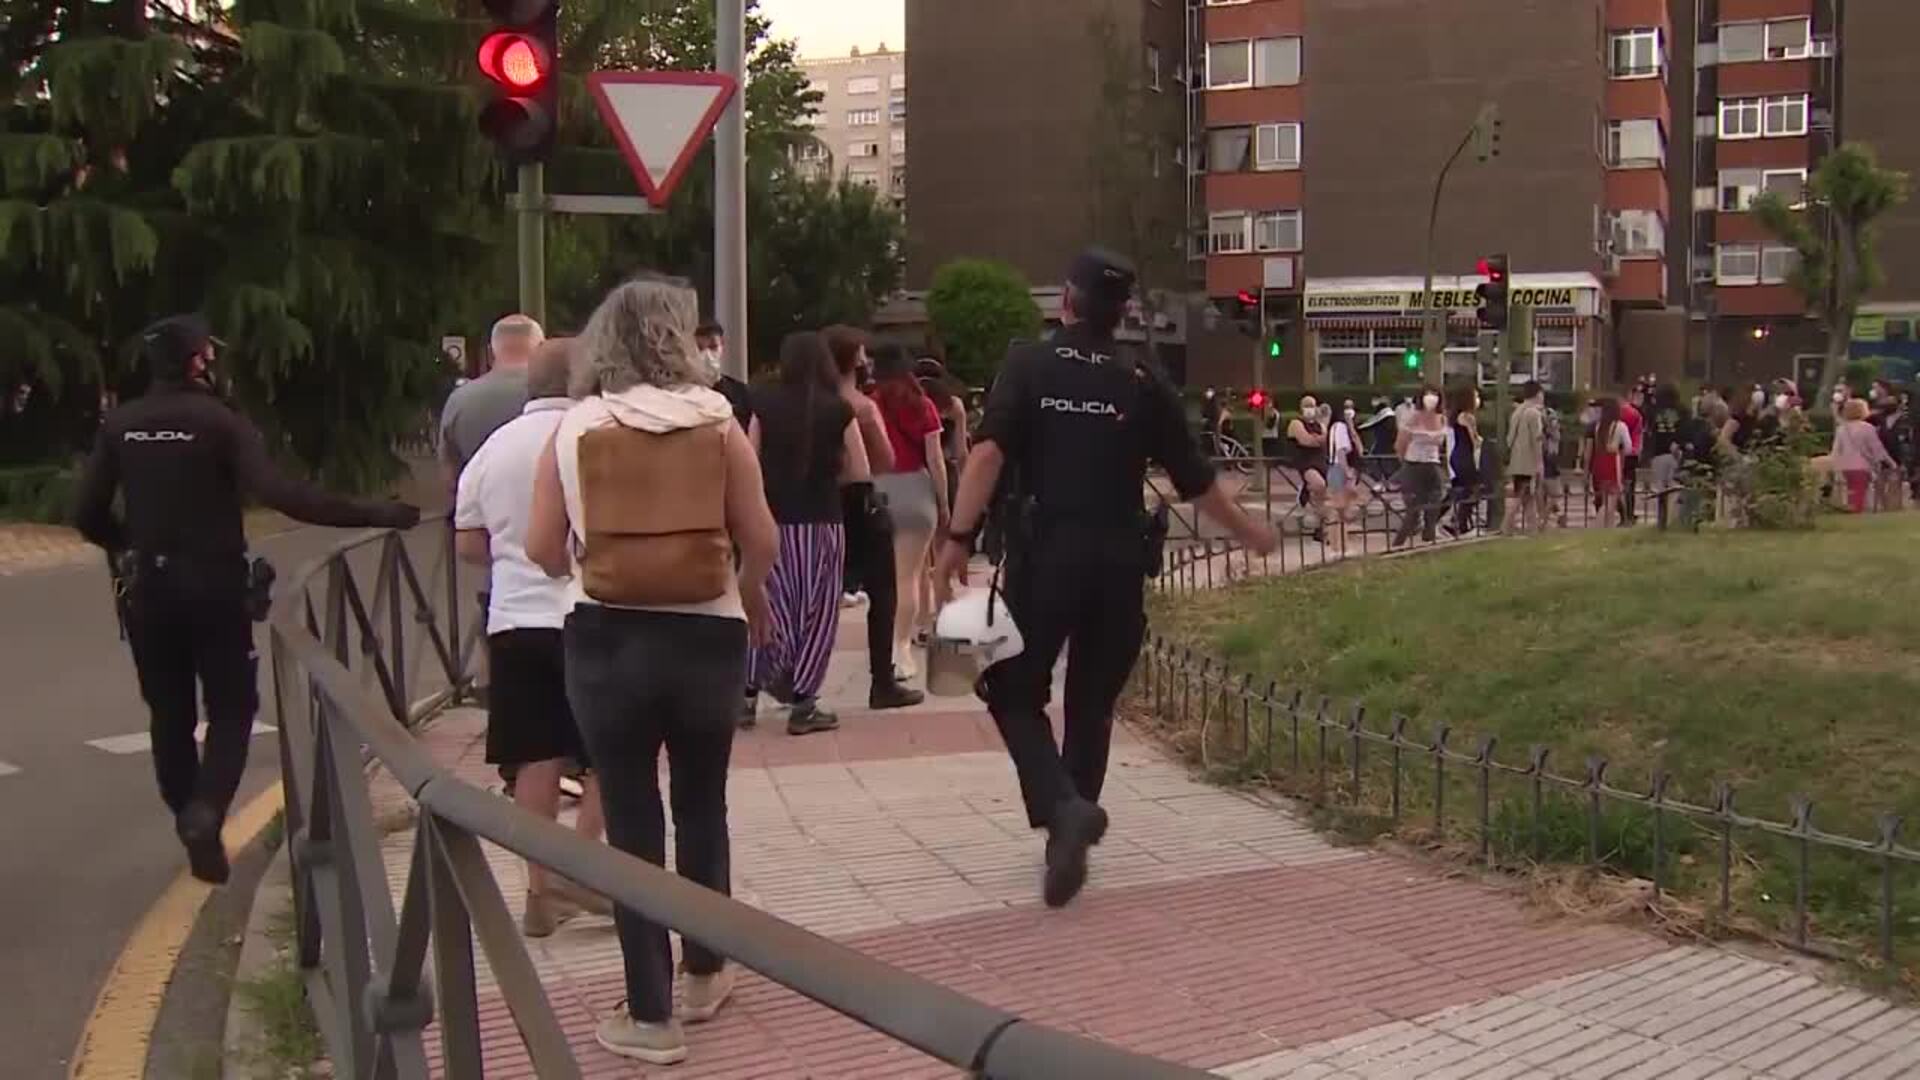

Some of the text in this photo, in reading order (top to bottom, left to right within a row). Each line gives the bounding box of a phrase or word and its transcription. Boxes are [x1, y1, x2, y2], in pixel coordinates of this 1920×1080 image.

[1511, 288, 1571, 306] COCINA
[1055, 347, 1111, 364] OLIC
[1040, 396, 1117, 415] POLICIA
